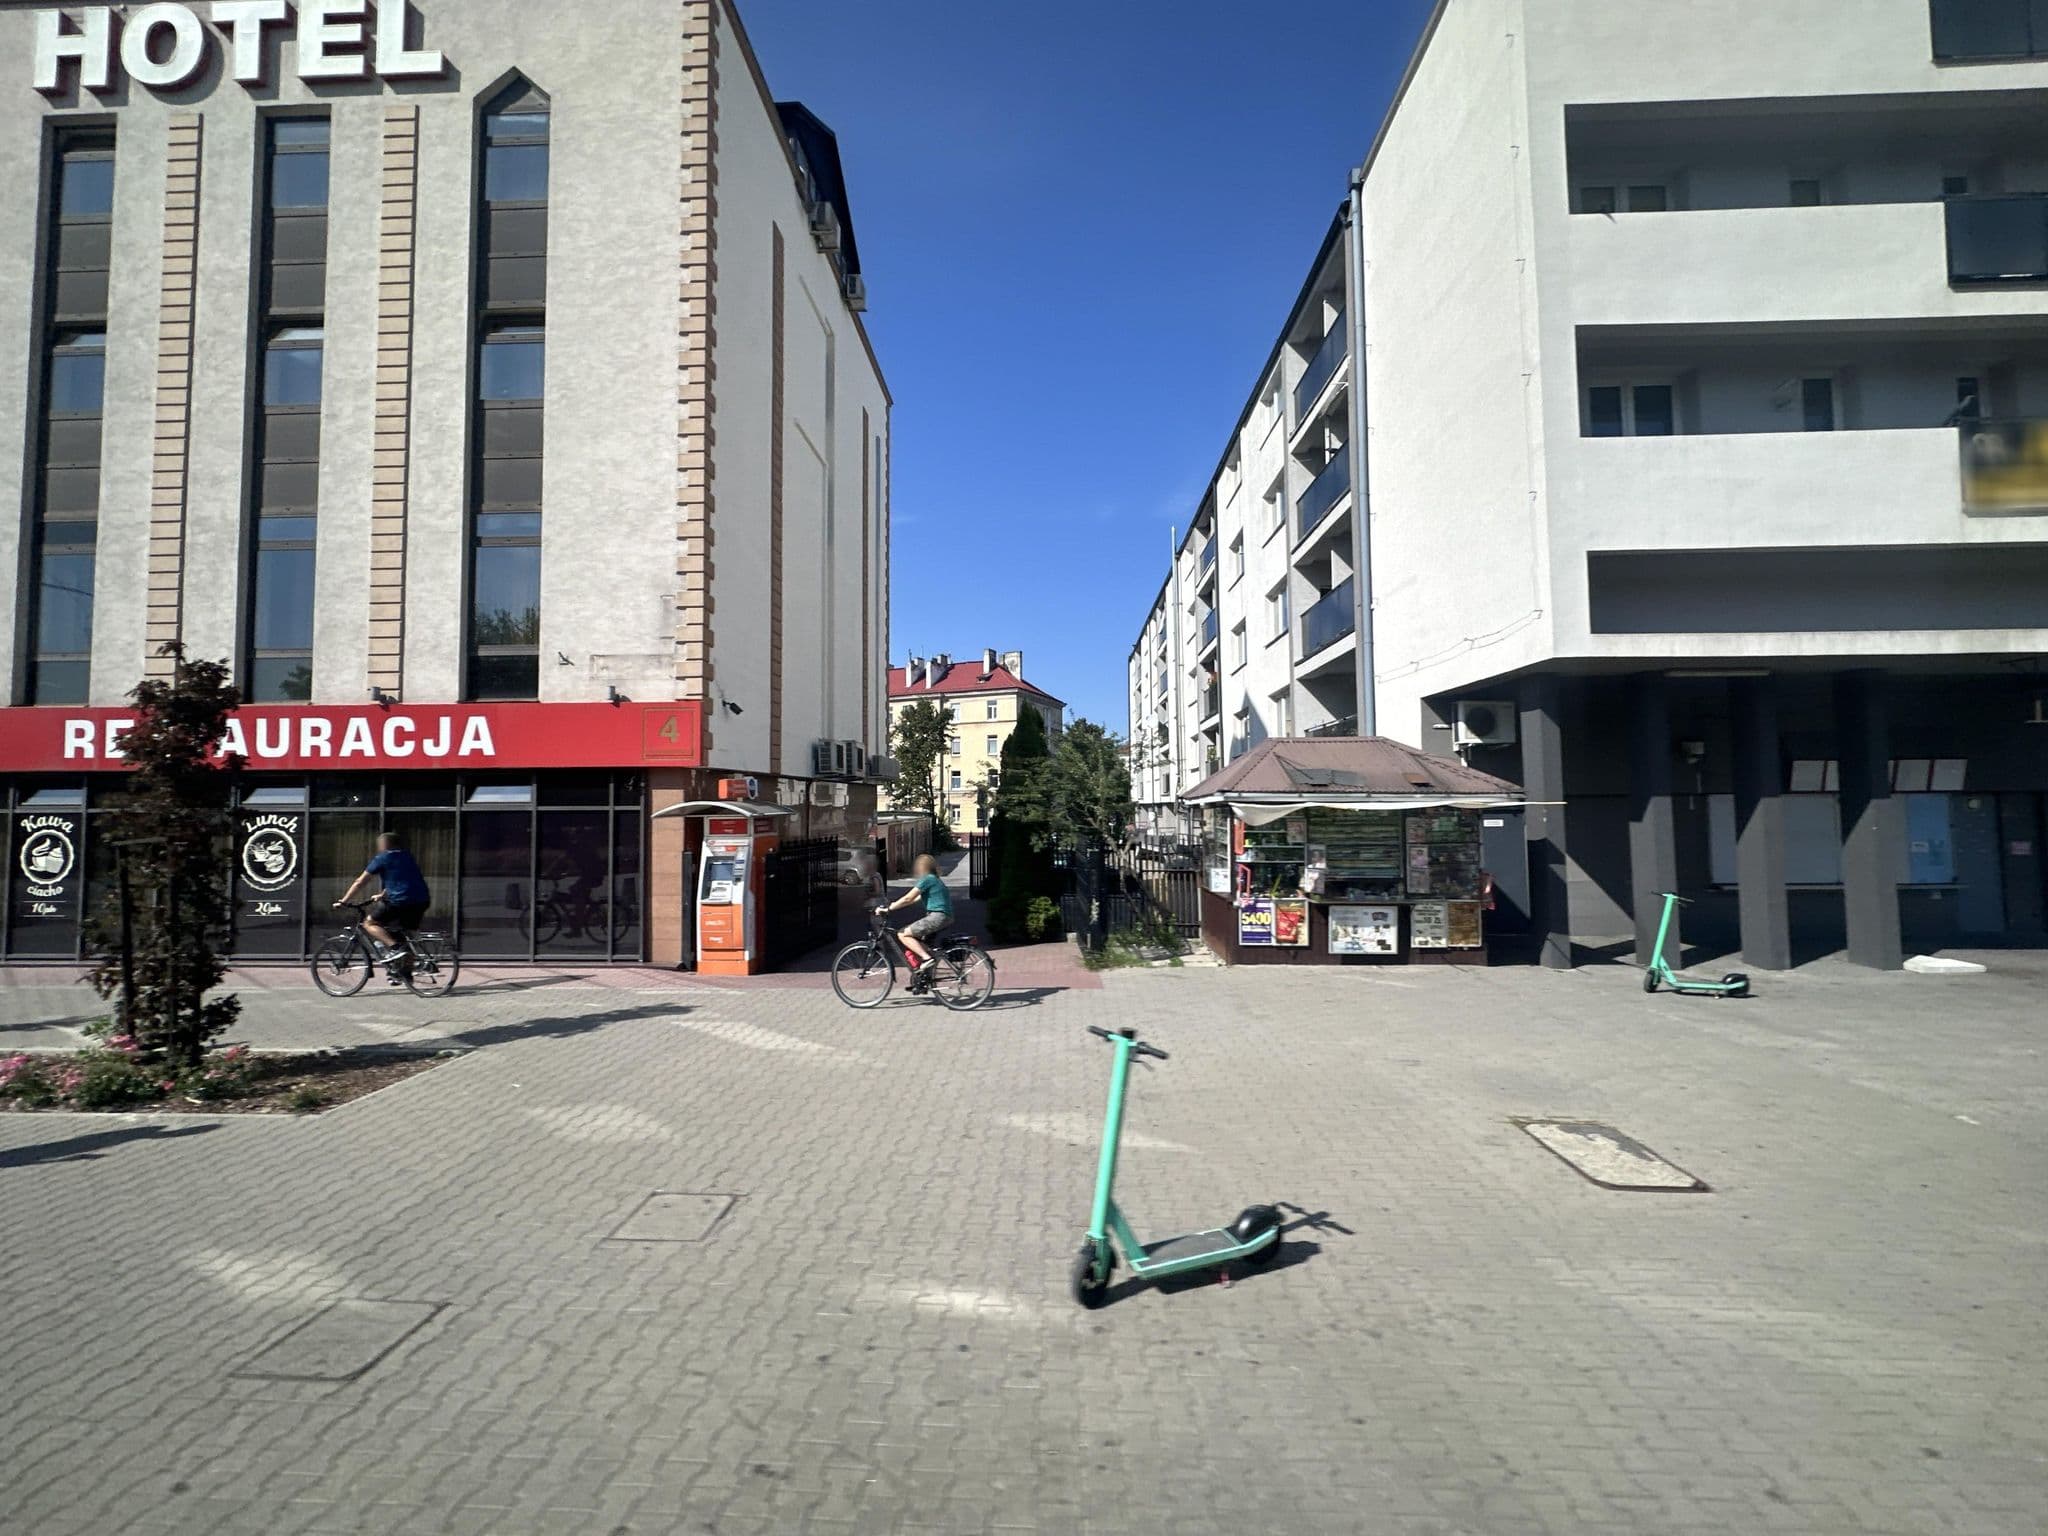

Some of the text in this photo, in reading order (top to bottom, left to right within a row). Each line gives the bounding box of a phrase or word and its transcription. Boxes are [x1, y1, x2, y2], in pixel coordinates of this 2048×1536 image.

[33, 0, 443, 89] HOTEL
[65, 716, 496, 758] REAURACJA
[658, 715, 679, 743] 4
[21, 815, 74, 833] Kawa
[241, 814, 299, 833] Lunch
[27, 885, 64, 897] ciacho
